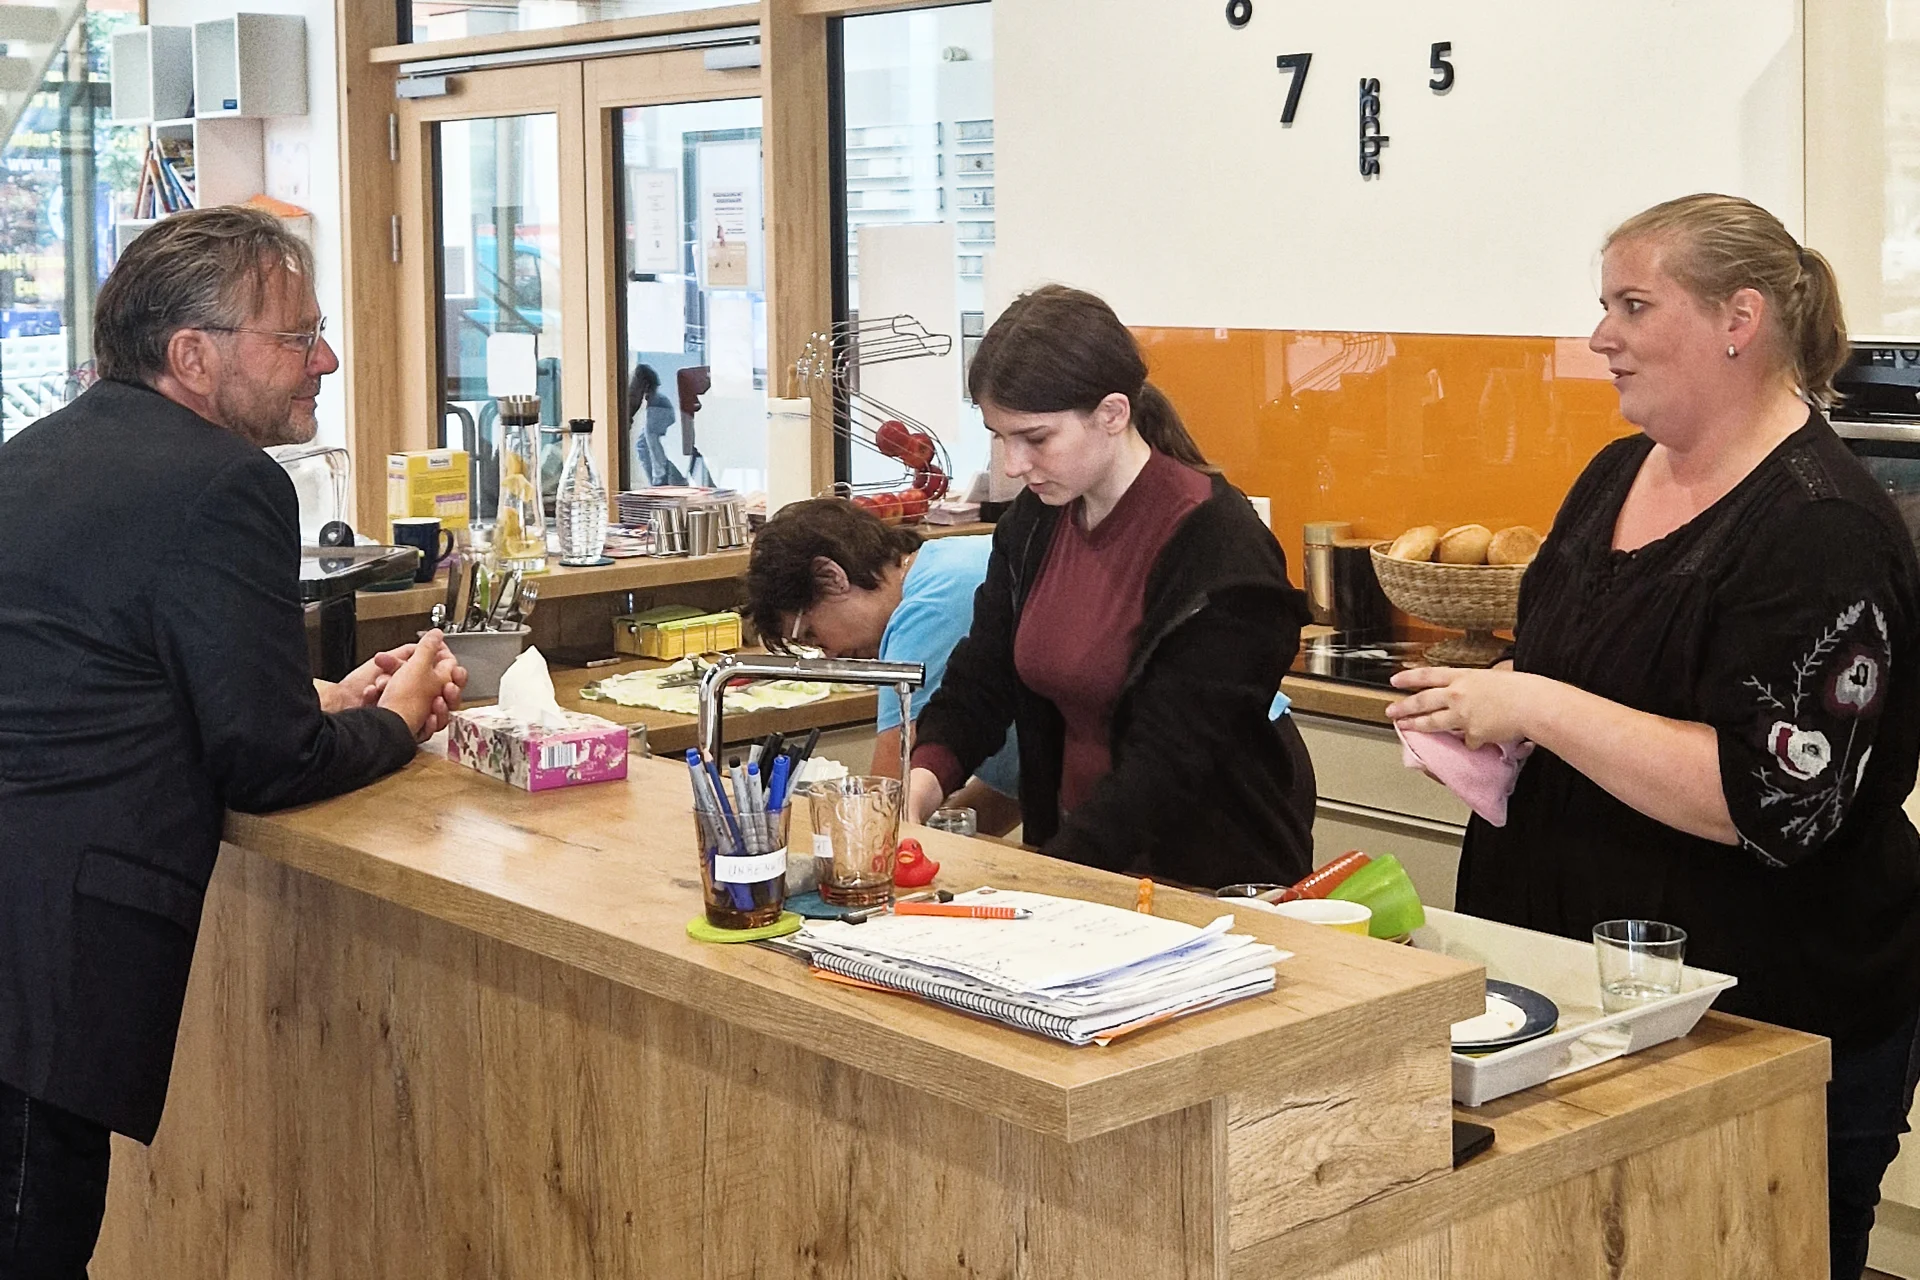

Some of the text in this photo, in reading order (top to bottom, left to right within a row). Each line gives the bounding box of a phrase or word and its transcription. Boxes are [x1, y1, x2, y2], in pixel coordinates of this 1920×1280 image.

[1276, 52, 1314, 124] 7
[1428, 41, 1455, 93] 5
[1359, 77, 1390, 177] sechs
